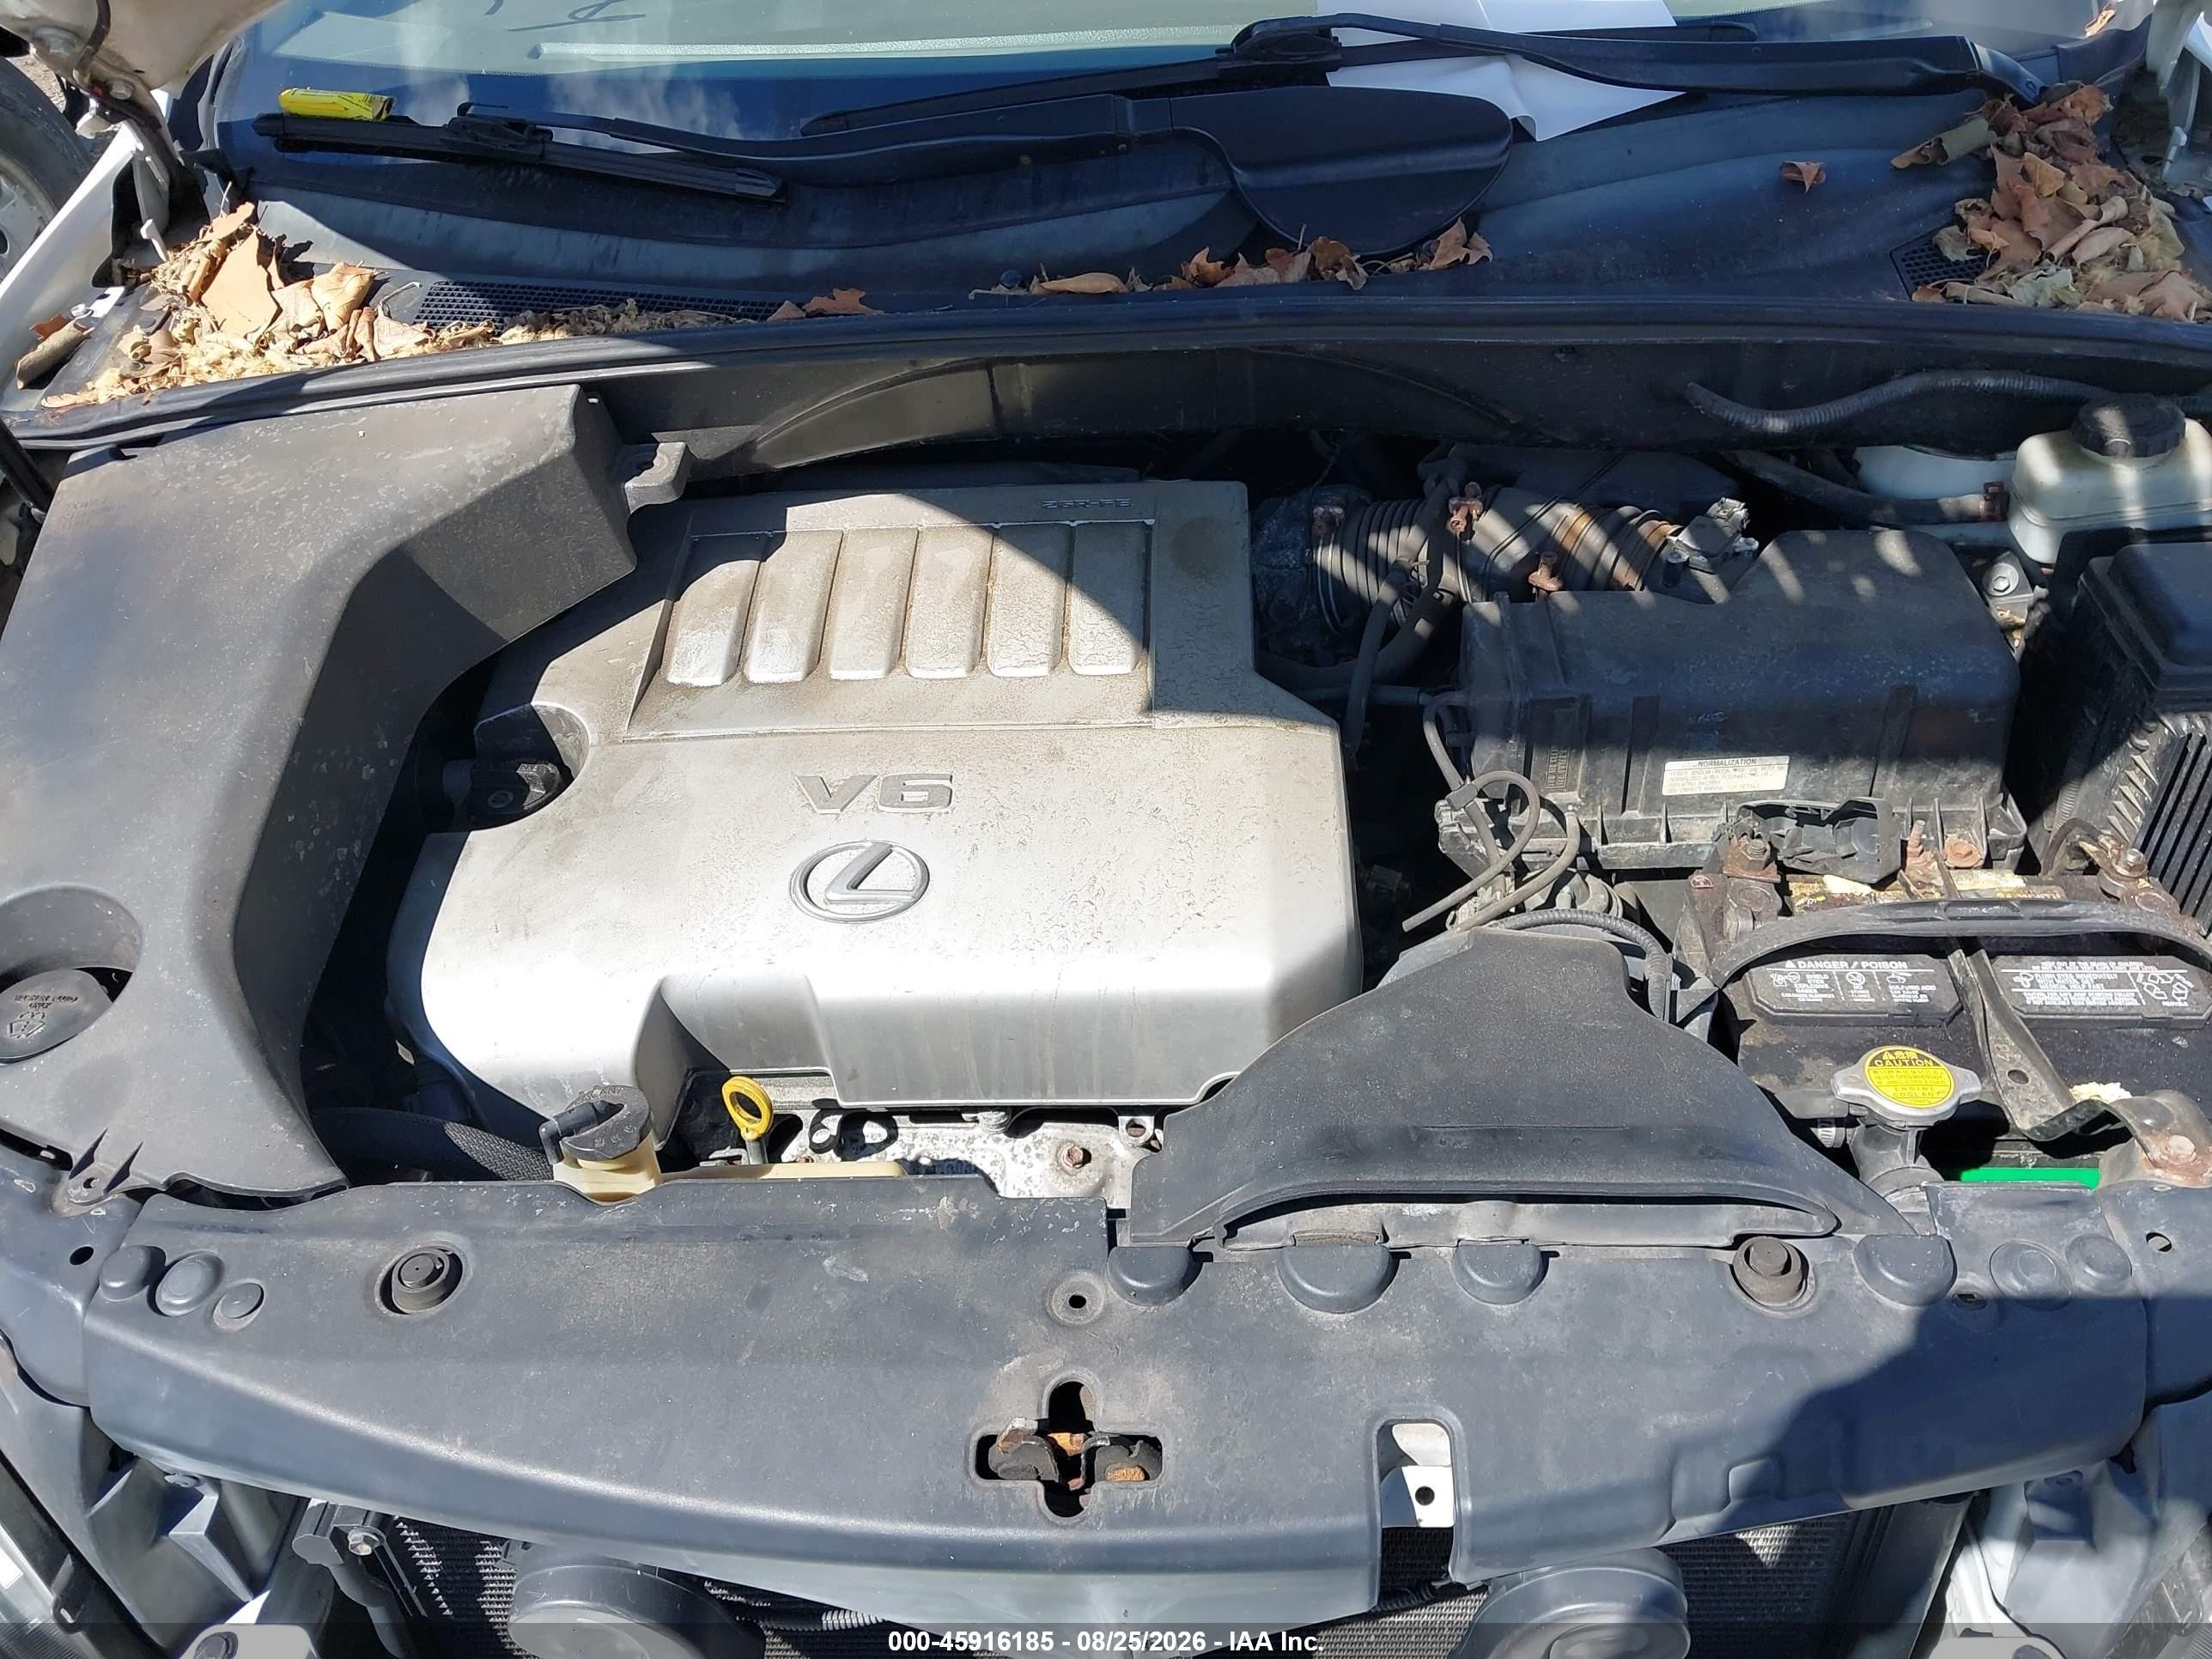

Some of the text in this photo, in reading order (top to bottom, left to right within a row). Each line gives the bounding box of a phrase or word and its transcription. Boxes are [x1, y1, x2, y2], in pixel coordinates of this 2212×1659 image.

[1698, 758, 1757, 768] NORMALIZATION
[795, 773, 952, 814] V6
[1797, 961, 1850, 969] DANGER
[1860, 961, 1909, 969] POISON
